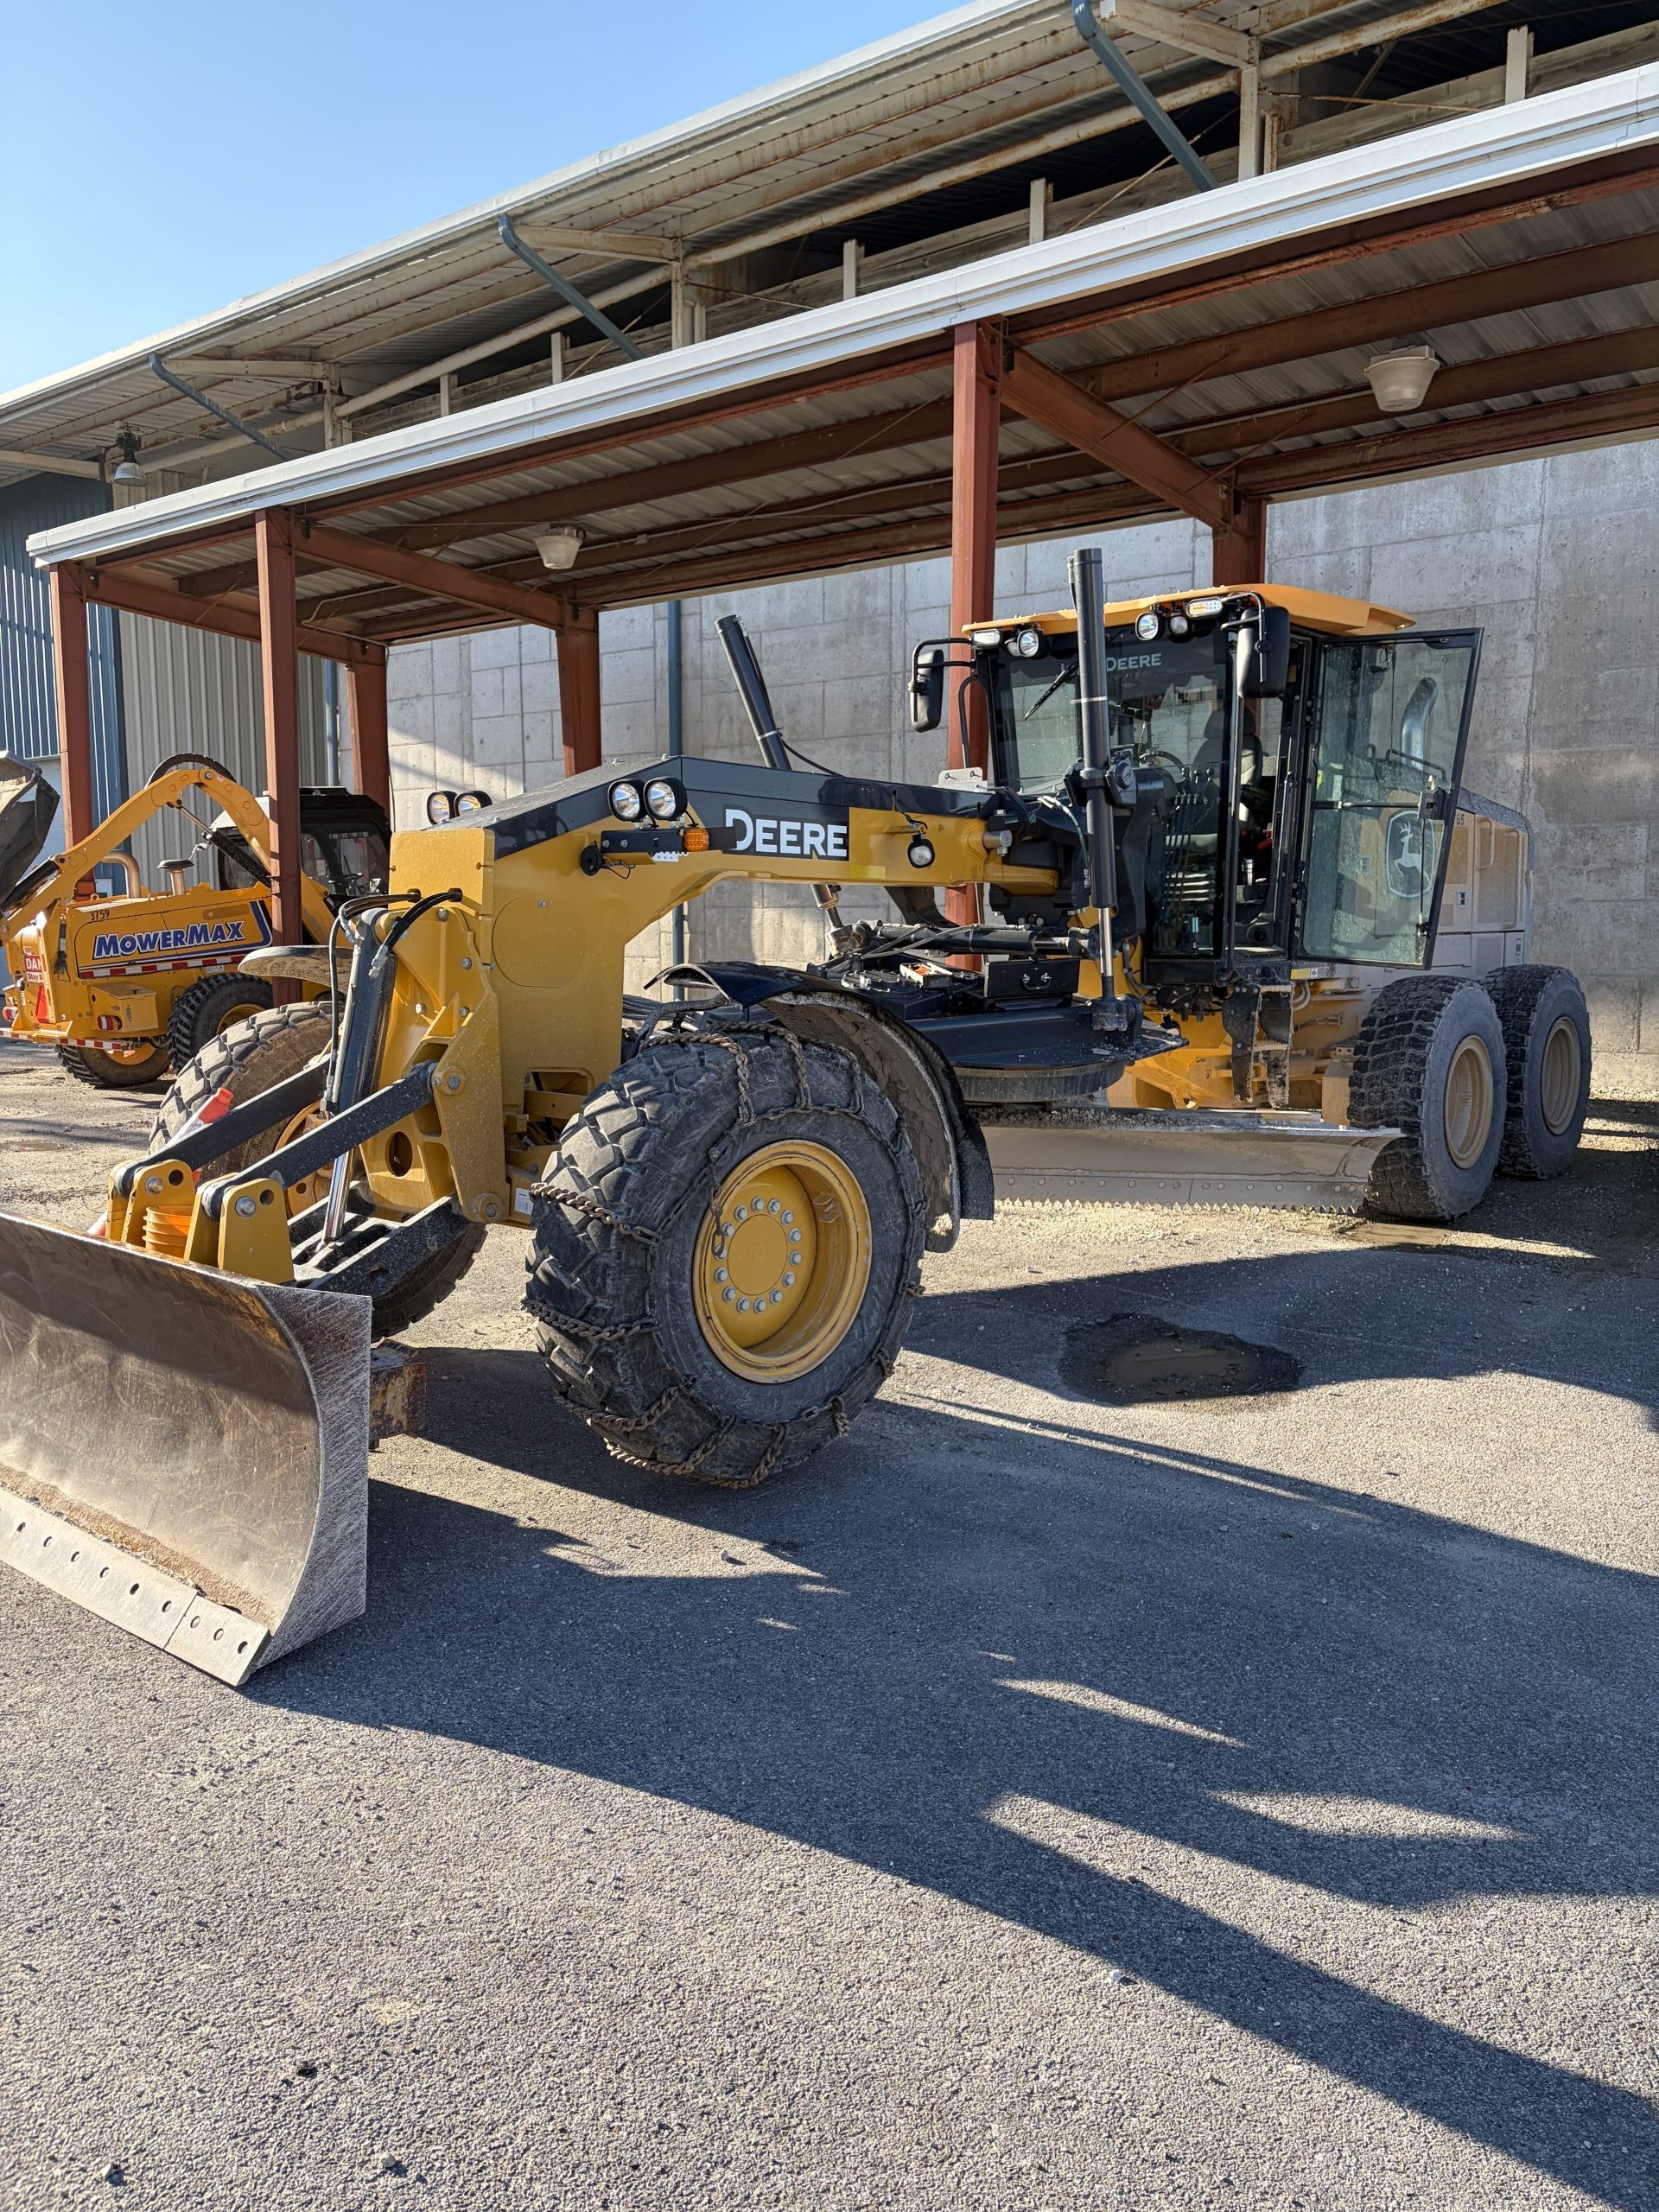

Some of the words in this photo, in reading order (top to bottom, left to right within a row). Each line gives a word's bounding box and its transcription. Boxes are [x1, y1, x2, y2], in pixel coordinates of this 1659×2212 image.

[1106, 653, 1162, 672] DEERE
[725, 808, 848, 858] DEERE
[90, 910, 110, 921] 3759
